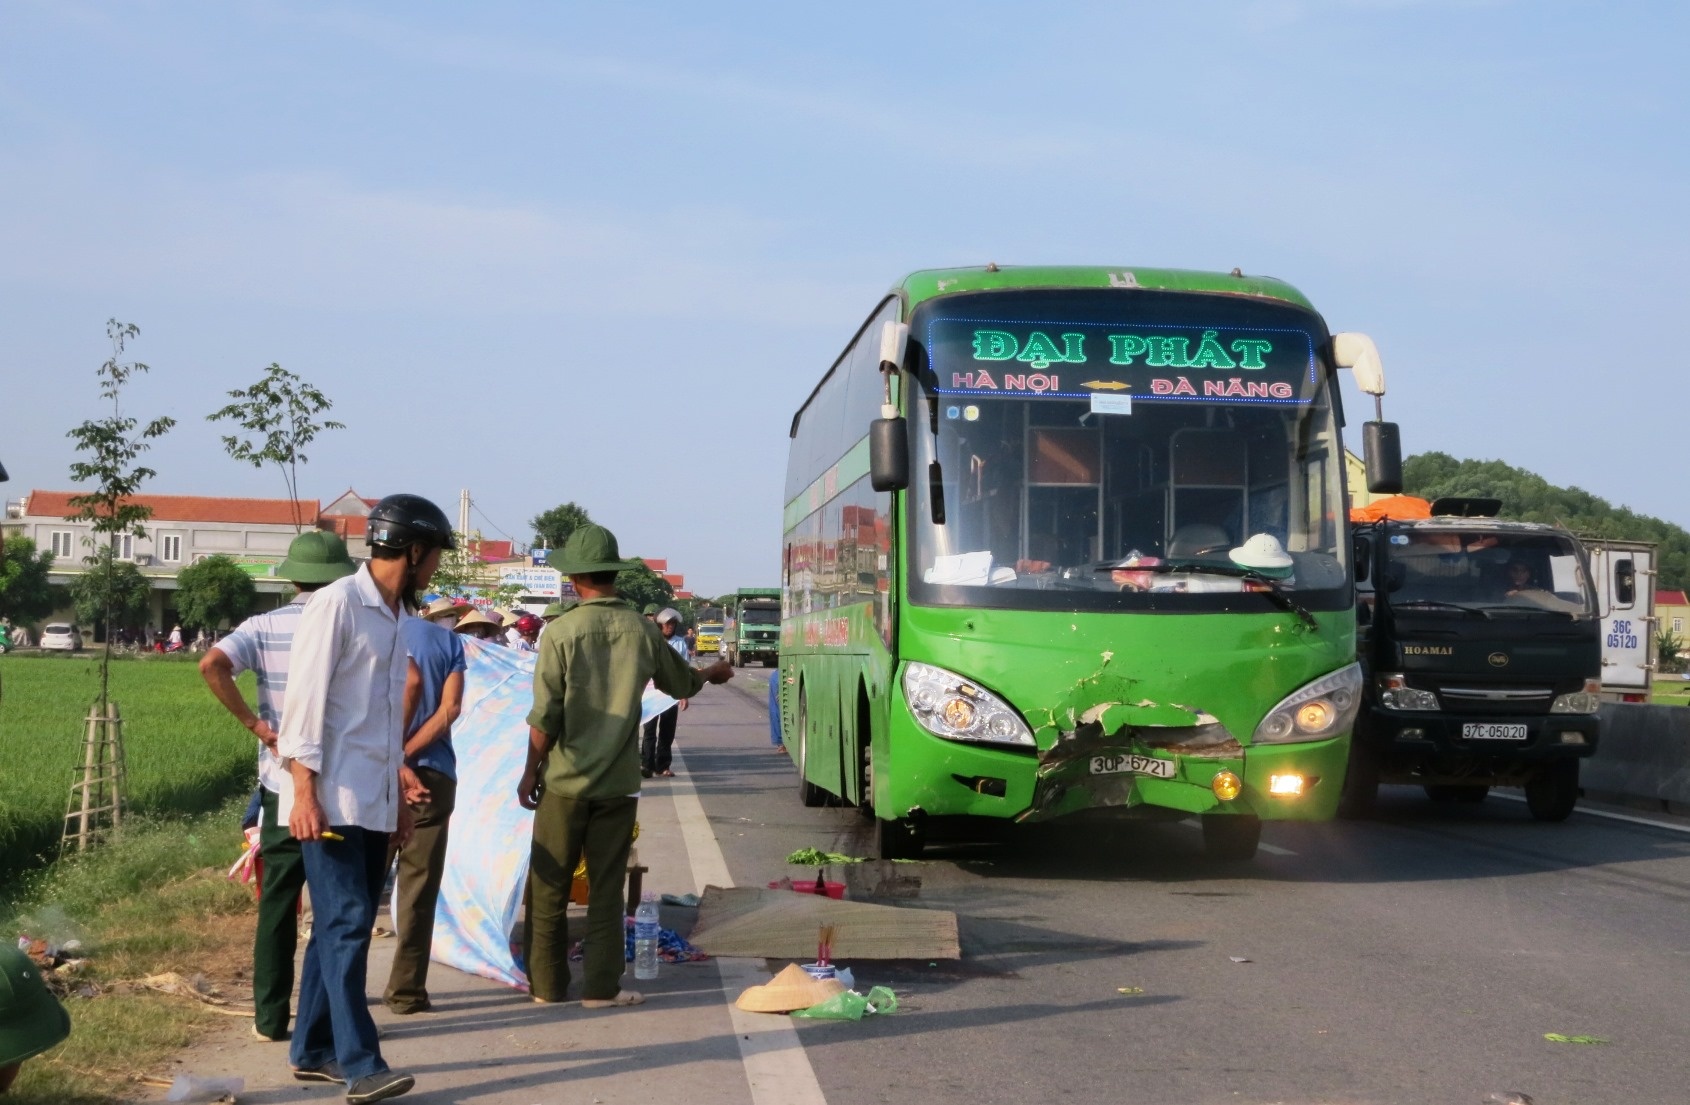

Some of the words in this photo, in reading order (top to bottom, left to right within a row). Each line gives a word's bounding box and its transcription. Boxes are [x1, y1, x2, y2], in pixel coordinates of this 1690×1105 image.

[972, 330, 1087, 369] ĐẠI
[1108, 330, 1272, 369] PHÁT
[952, 369, 998, 389] HÀ
[1004, 373, 1059, 394] NỘI
[1150, 376, 1197, 396] ĐÀ
[1612, 619, 1632, 634] 36C
[1607, 633, 1638, 649] 05120
